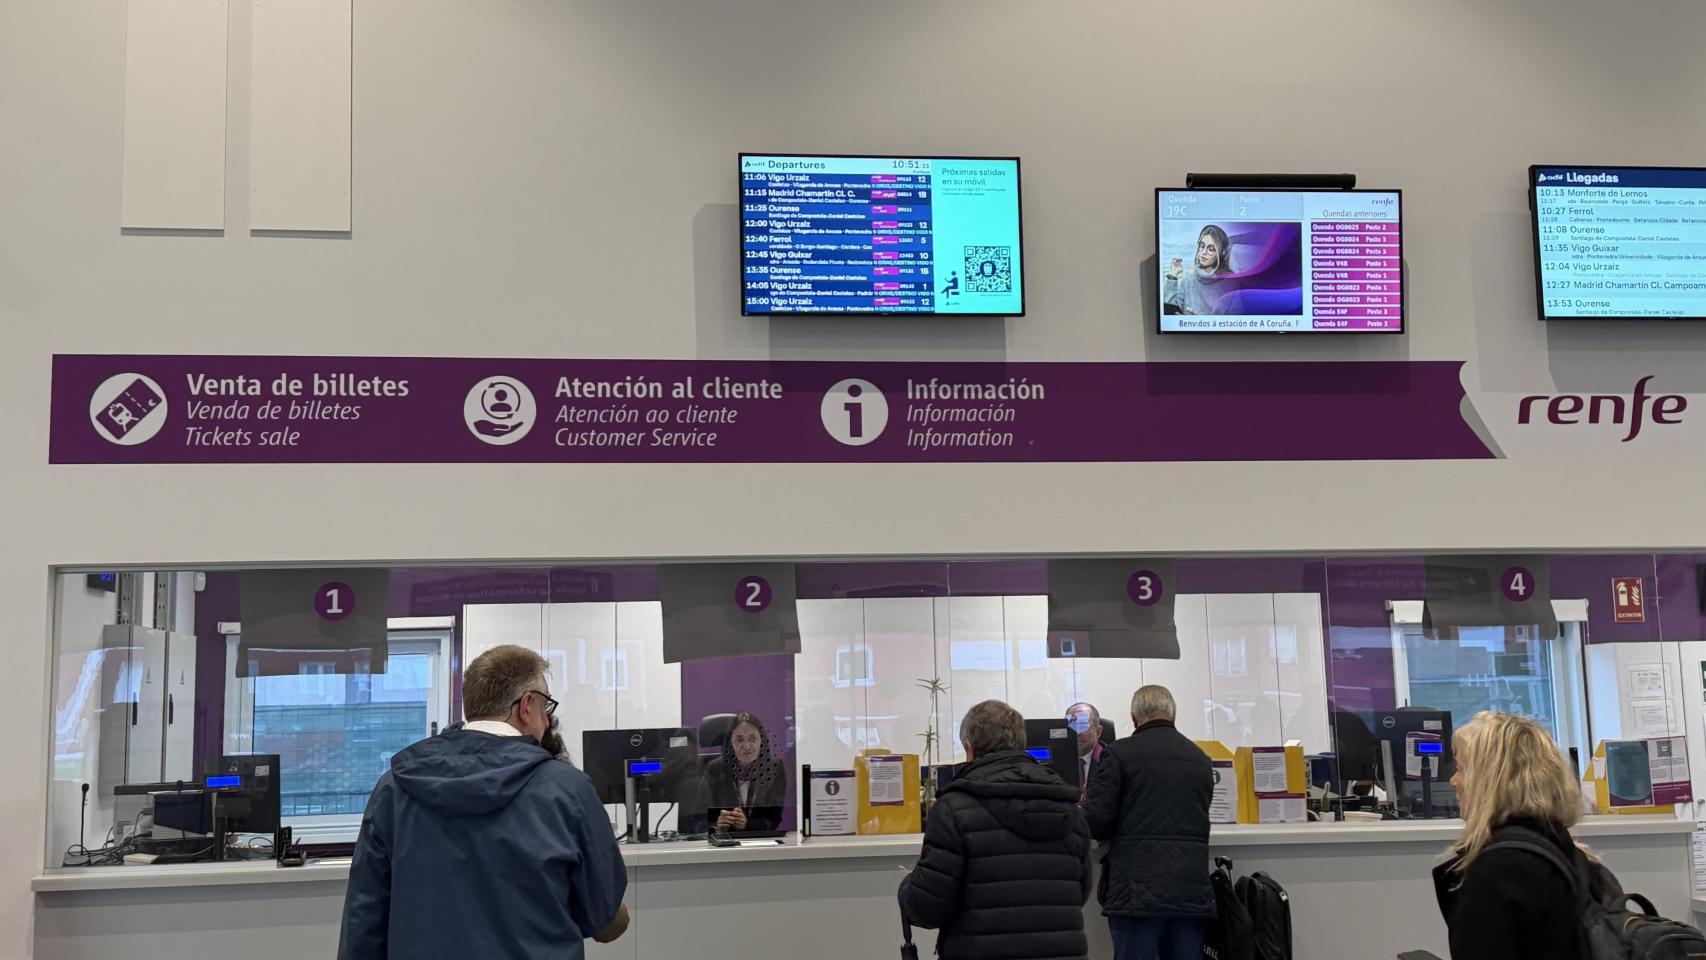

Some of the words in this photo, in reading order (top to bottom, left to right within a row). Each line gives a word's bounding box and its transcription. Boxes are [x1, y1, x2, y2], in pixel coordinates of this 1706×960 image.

[768, 160, 826, 170] Departures
[892, 160, 920, 168] 10:51
[942, 168, 978, 176] Próximas
[768, 174, 786, 182] Vigo
[1566, 173, 1619, 184] Llegadas
[1168, 195, 1196, 203] Quenda
[1240, 207, 1247, 215] 2
[768, 220, 786, 228] Vigo
[770, 251, 787, 259] Vigo
[1571, 244, 1590, 253] Vigo
[1572, 263, 1591, 272] Vigo
[770, 282, 787, 290] Vigo
[770, 298, 787, 306] Vigo
[186, 374, 262, 396] Venta
[272, 374, 304, 396] de
[313, 374, 409, 396] billetes
[555, 376, 663, 399] Atención
[672, 377, 693, 399] al
[702, 377, 783, 399] cliente
[907, 378, 1045, 400] Información
[186, 400, 250, 420] Venda
[257, 400, 281, 420] de
[288, 400, 361, 420] billetes
[556, 405, 639, 423] Atención
[646, 409, 669, 423] ao
[676, 405, 737, 423] cliente
[906, 404, 1015, 426] Información
[1518, 375, 1688, 442] renfe
[185, 426, 251, 446] Tickets
[258, 427, 300, 446] sale
[555, 428, 645, 446] Customer
[651, 428, 717, 446] Service
[908, 429, 1013, 450] Information
[1138, 577, 1152, 600] 3
[1510, 573, 1525, 595] 4
[326, 589, 343, 613] 1
[745, 582, 761, 606] 2
